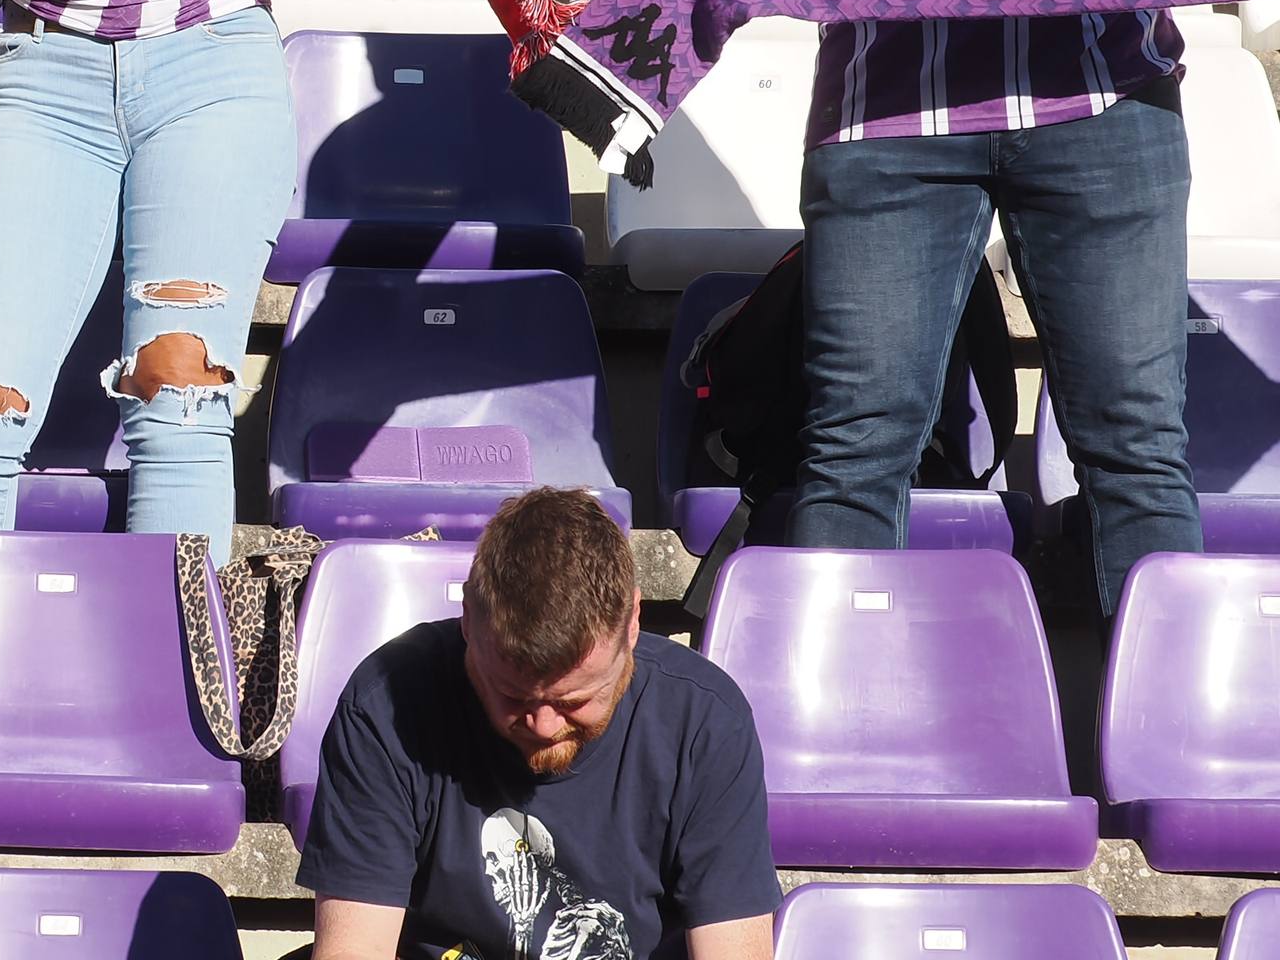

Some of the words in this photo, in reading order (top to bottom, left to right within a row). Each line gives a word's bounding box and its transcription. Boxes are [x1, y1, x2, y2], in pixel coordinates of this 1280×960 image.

[759, 80, 771, 88] 60
[433, 313, 446, 322] 62
[1195, 322, 1207, 331] 58
